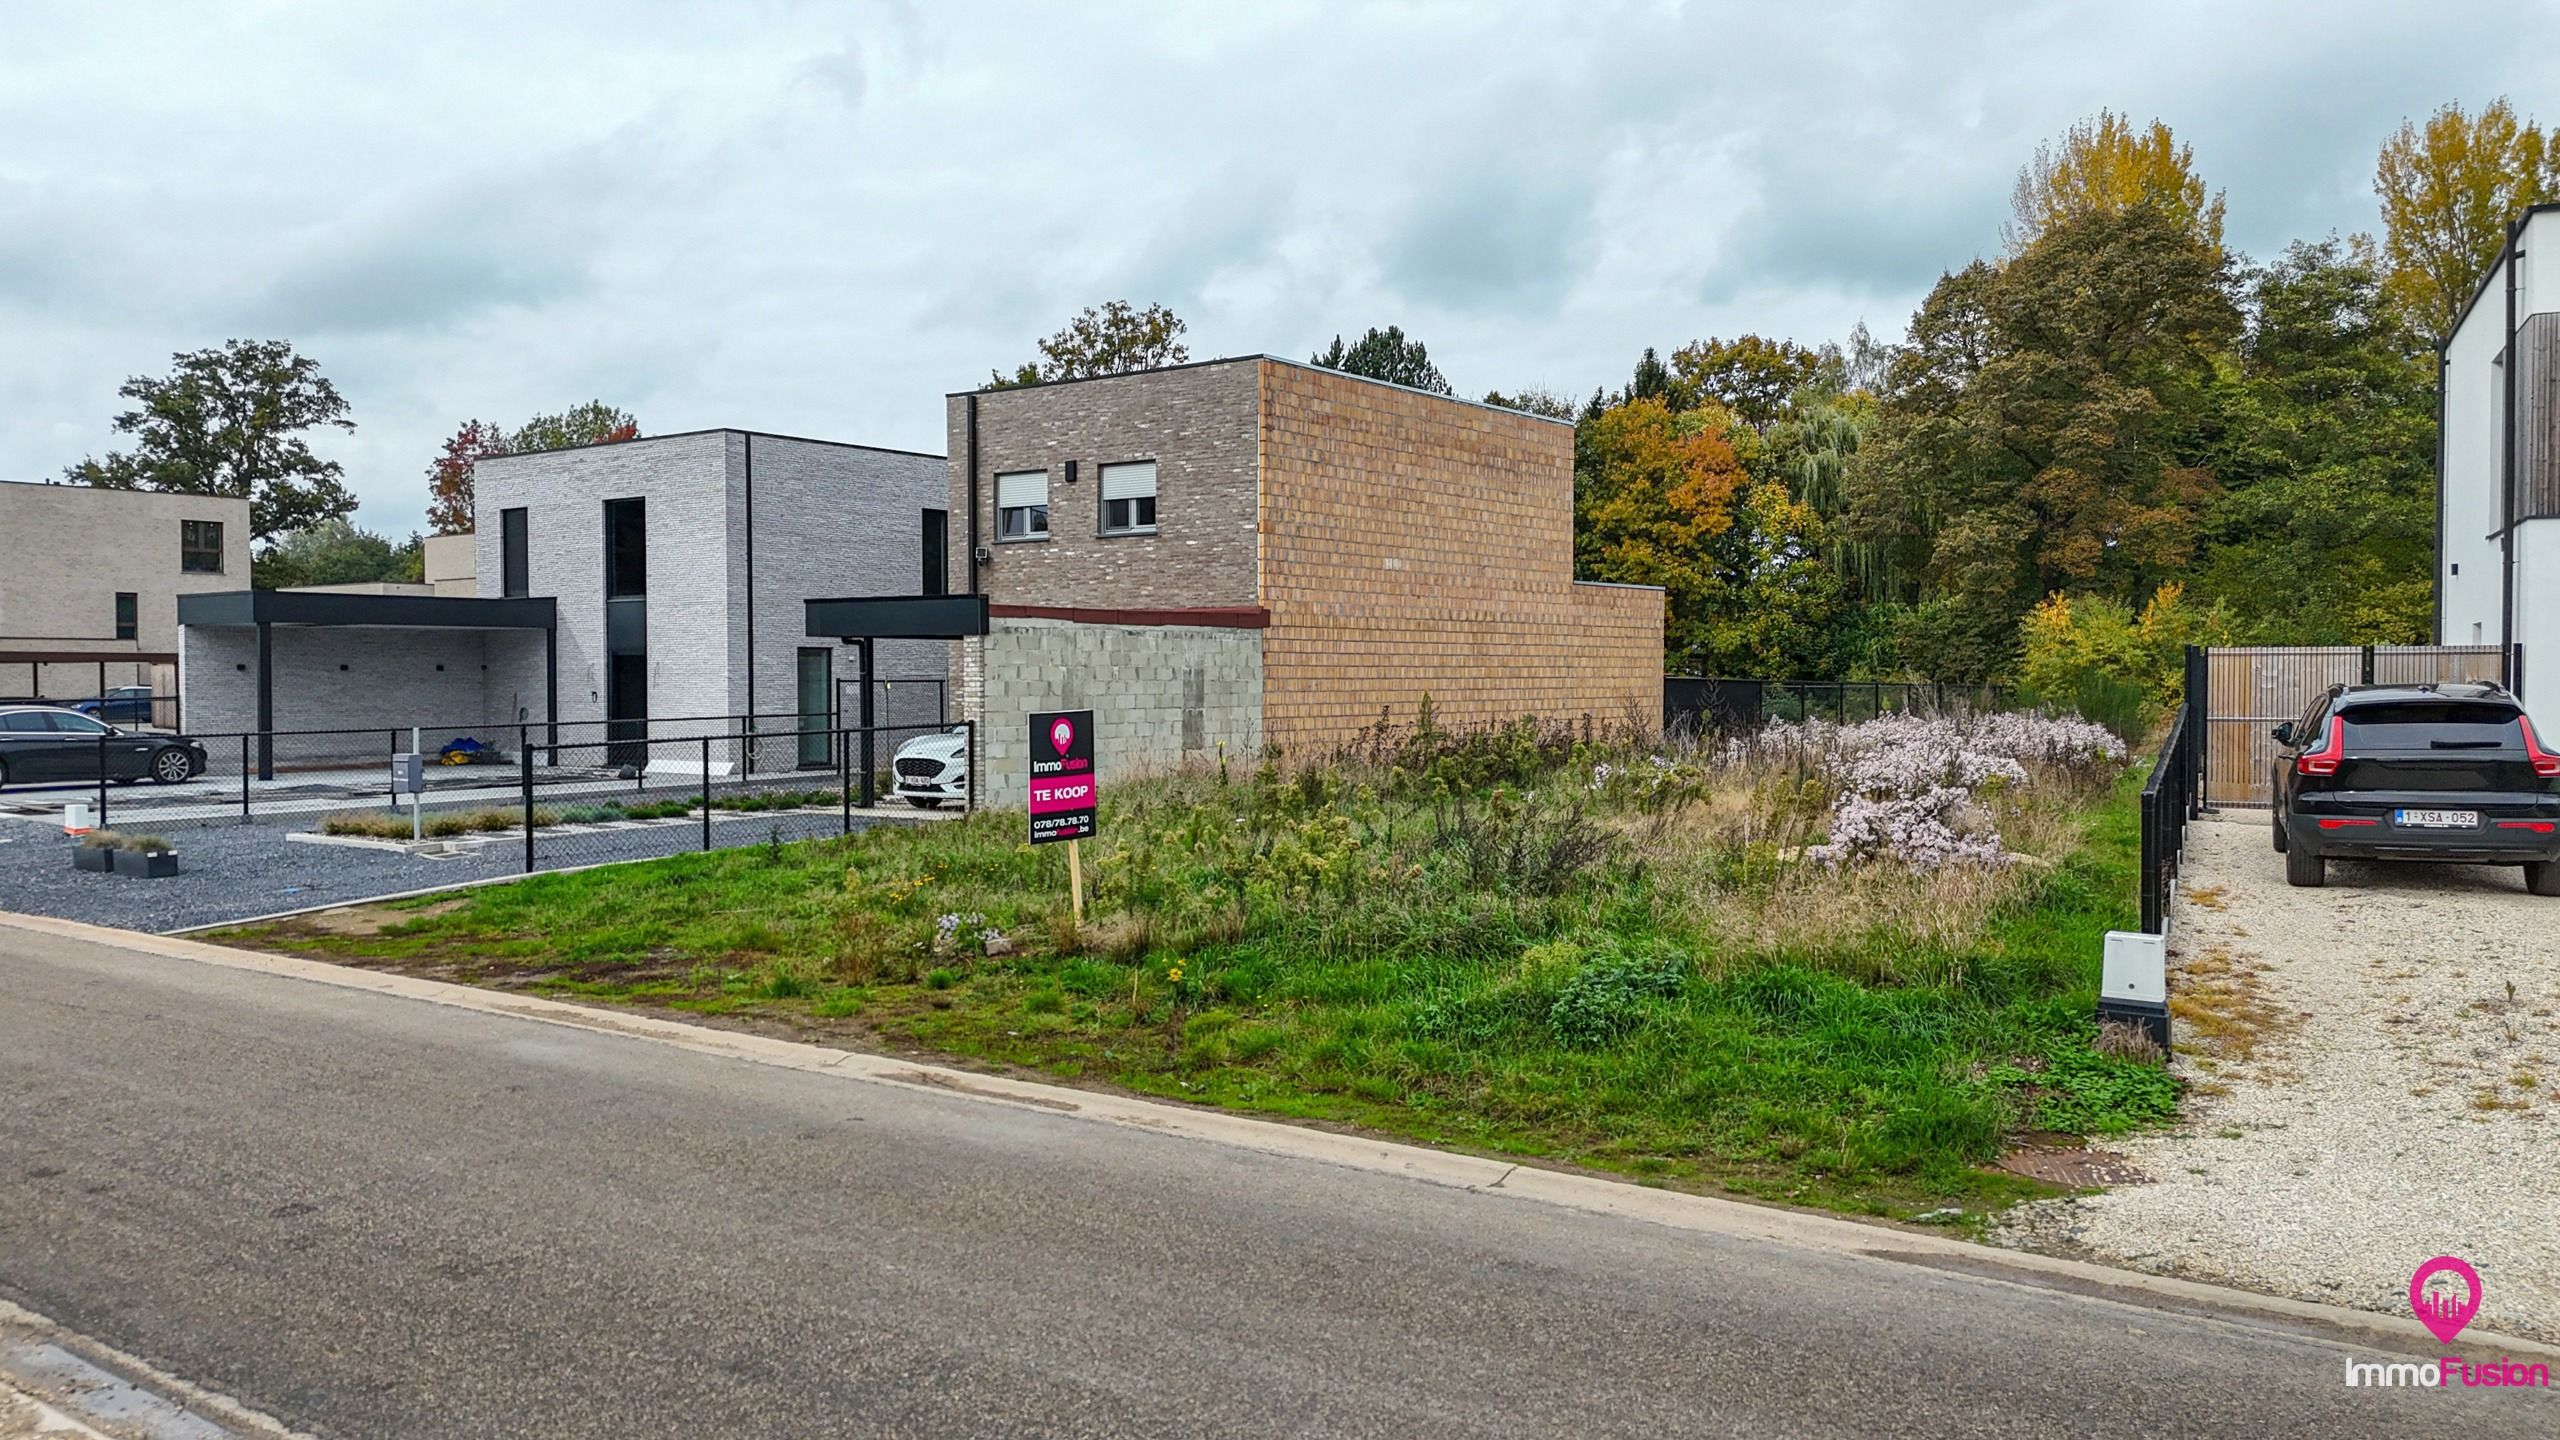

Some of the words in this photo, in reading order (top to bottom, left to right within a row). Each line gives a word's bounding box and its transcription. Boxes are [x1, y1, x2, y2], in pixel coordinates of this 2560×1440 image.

[1033, 789, 1051, 802] TE
[1054, 785, 1088, 800] KOOP
[1033, 815, 1089, 829] 078/78.78.70
[1033, 825, 1089, 839] Immo.be
